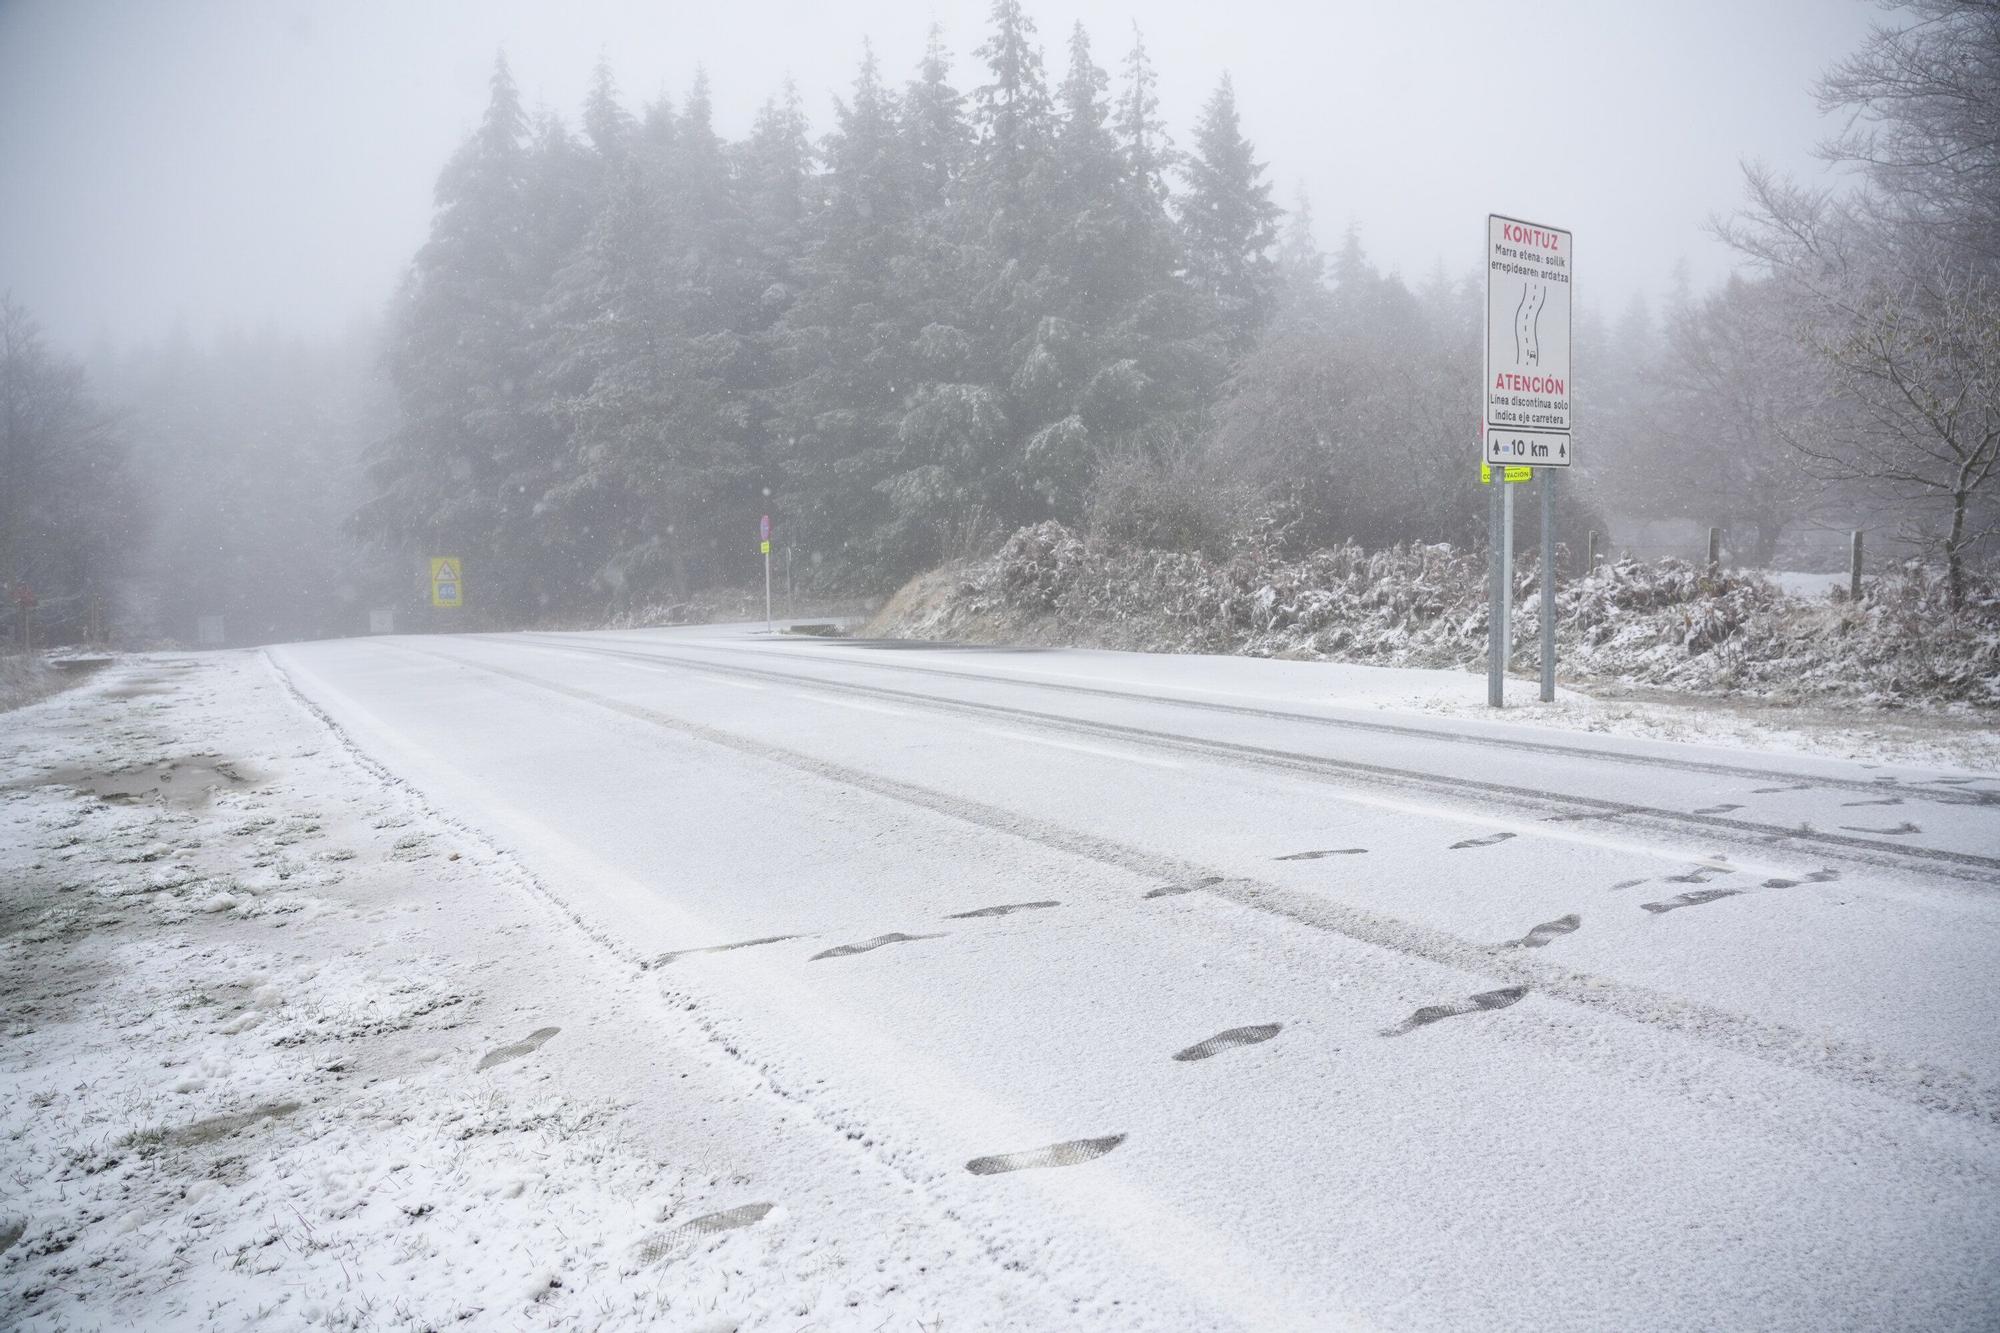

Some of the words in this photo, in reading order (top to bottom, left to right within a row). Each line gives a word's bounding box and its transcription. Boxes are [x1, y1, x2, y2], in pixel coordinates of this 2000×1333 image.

[1503, 223, 1558, 250] KONTUZ
[1495, 243, 1517, 258] Marra
[1519, 249, 1544, 263] etena:
[1545, 255, 1566, 267] soilik
[1491, 260, 1539, 277] errepidearen
[1541, 270, 1569, 283] ardatza
[1496, 373, 1564, 395] ATENCIÓN
[1511, 396, 1552, 409] discontinua
[1553, 400, 1569, 410] solo
[1495, 410, 1516, 422] indica
[1518, 412, 1530, 424] eje
[1531, 414, 1564, 424] carretera
[1511, 439, 1525, 456] 10
[1531, 440, 1549, 457] km
